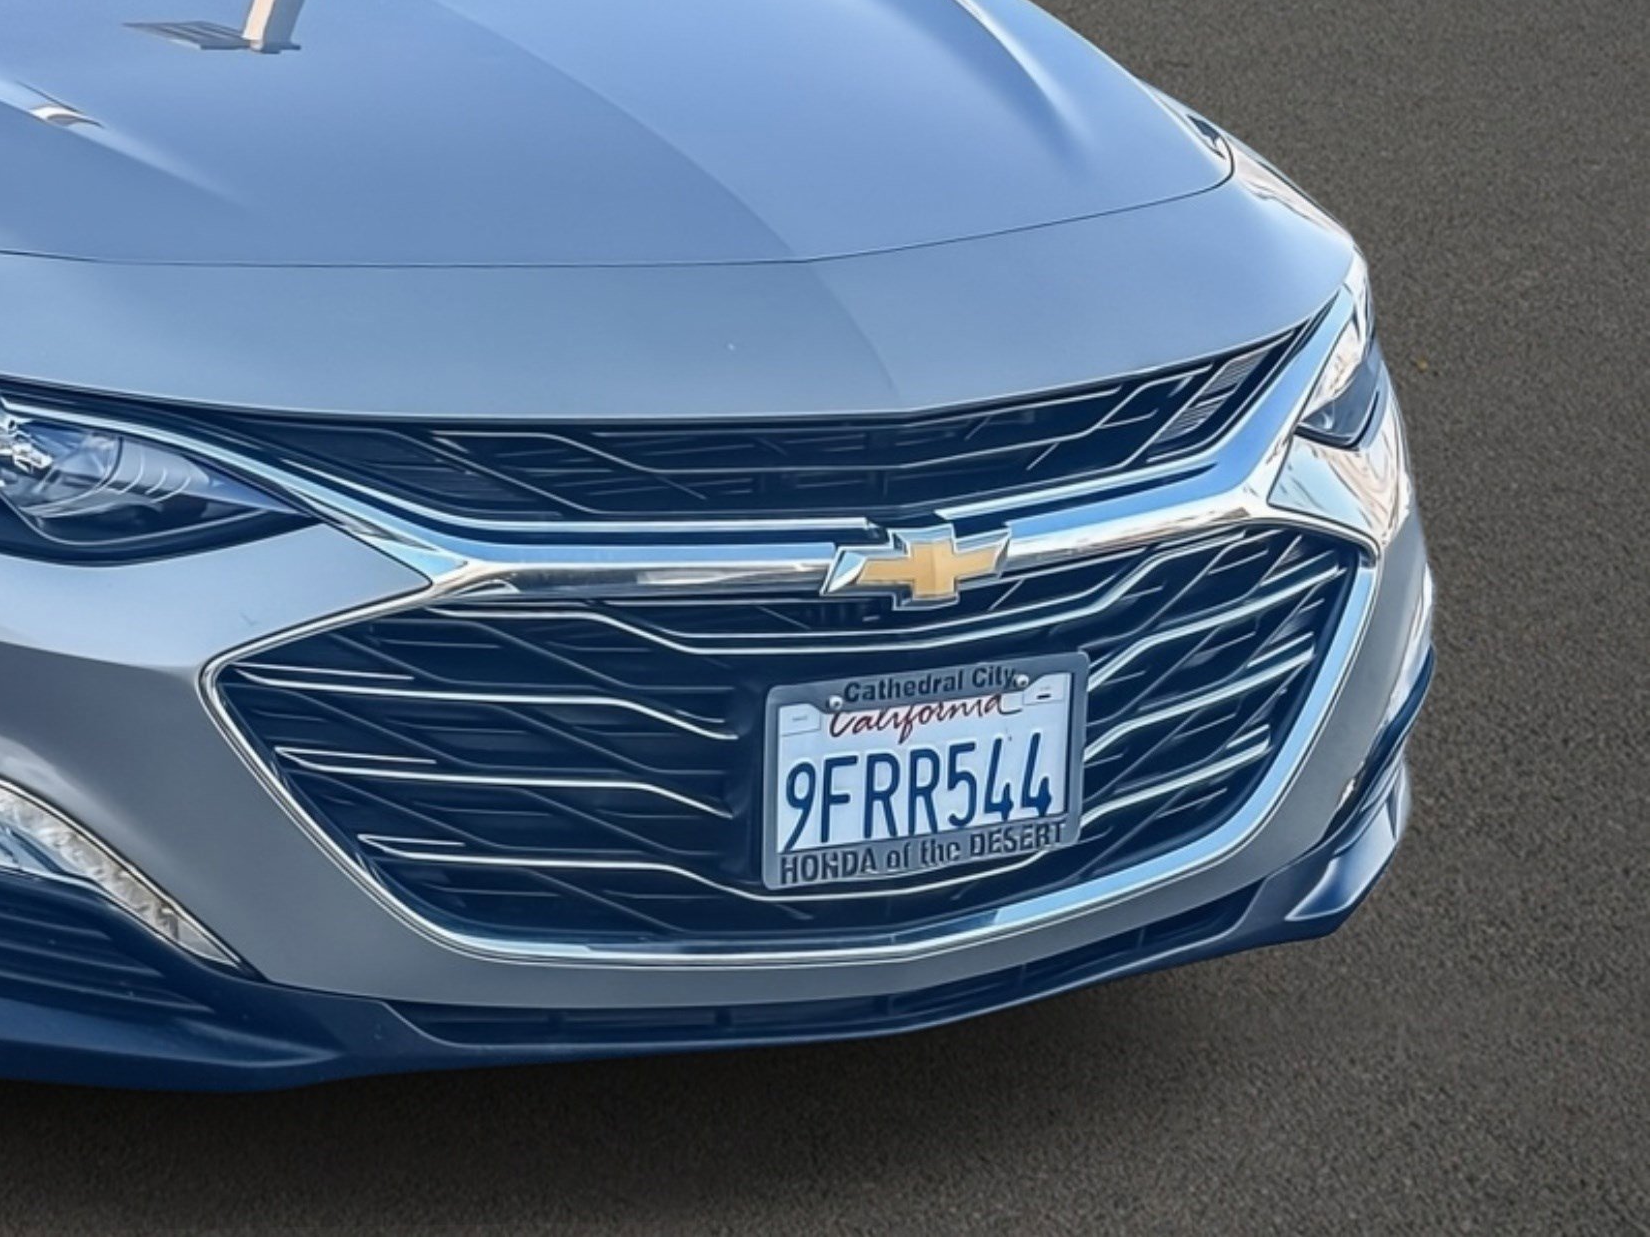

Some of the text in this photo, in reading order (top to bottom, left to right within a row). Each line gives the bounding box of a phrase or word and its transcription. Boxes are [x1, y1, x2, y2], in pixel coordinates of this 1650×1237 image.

[843, 665, 1017, 703] Cathedral City
[828, 694, 1023, 745] California
[781, 732, 1053, 852] 9FRR544
[780, 819, 1067, 885] HONDA of the DESERT
